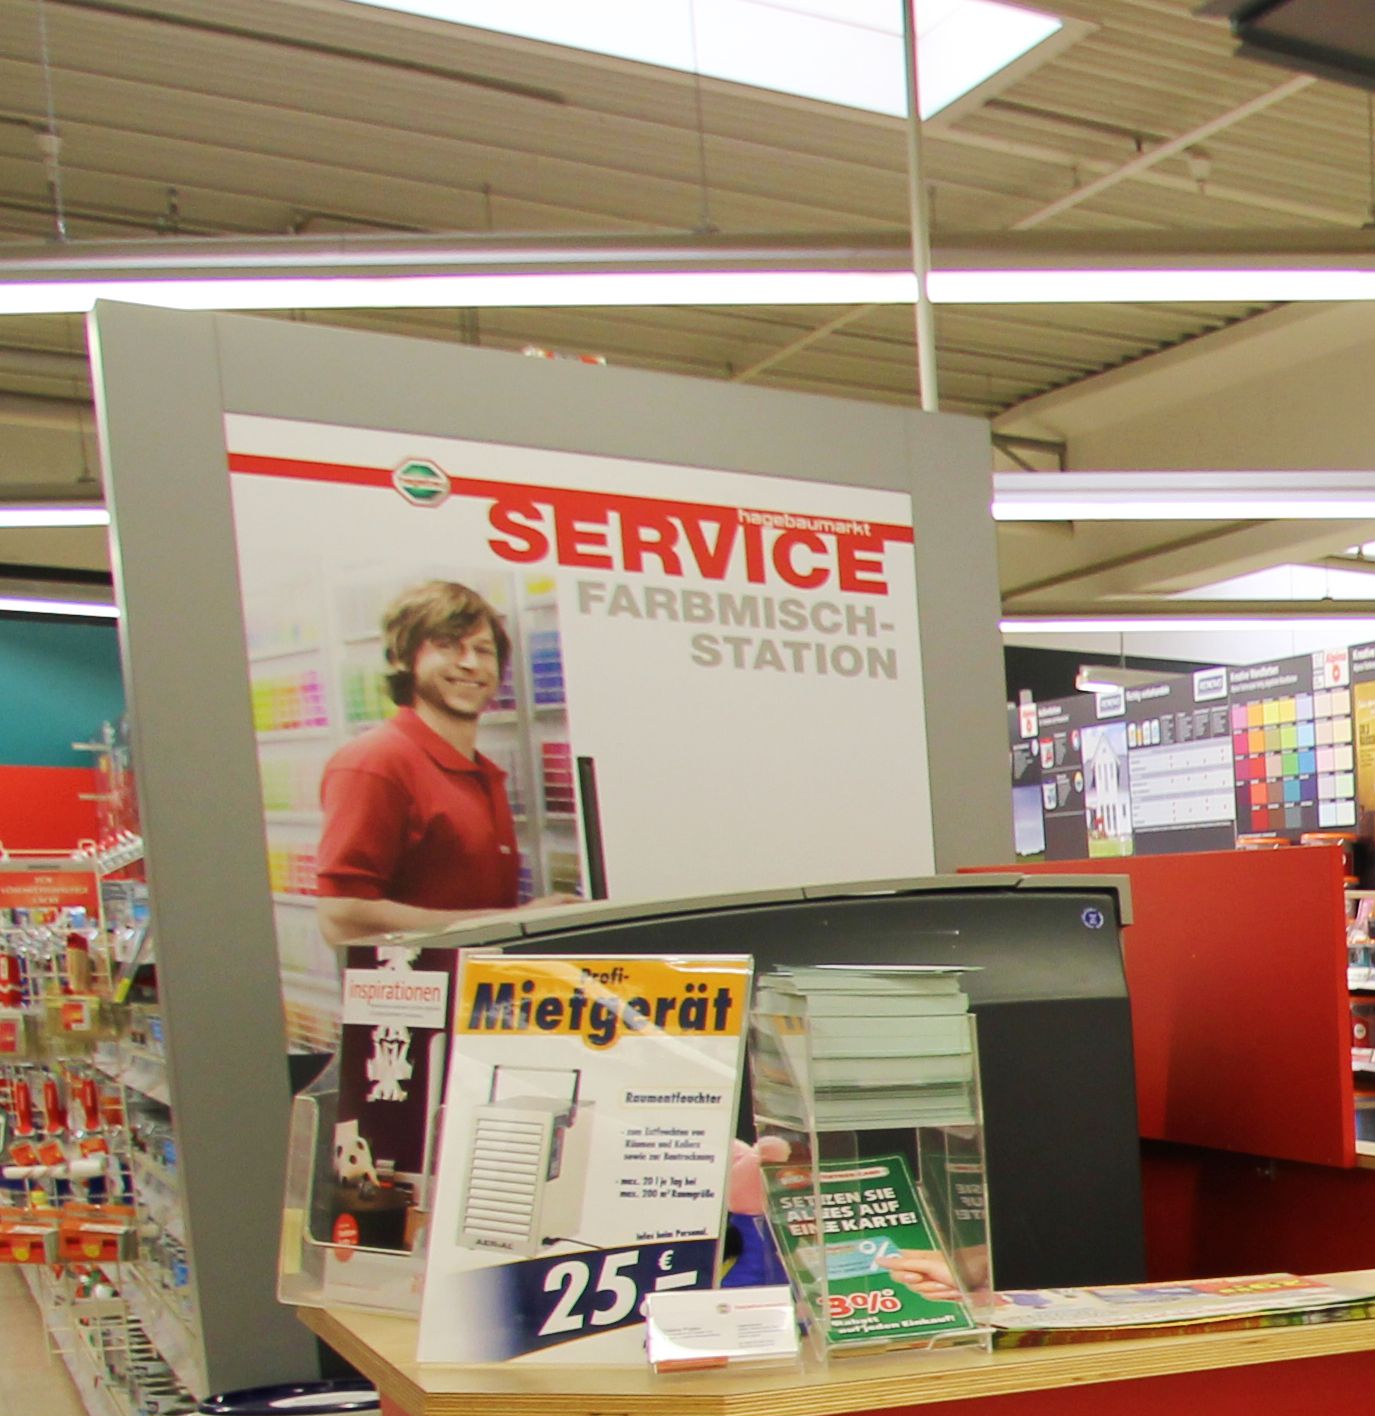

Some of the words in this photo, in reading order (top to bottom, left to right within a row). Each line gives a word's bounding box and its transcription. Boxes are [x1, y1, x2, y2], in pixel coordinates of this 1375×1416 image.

[737, 508, 872, 538] hagebaumarkt
[488, 499, 890, 596] SERVICE
[576, 580, 896, 638] FARBMISCH-
[690, 634, 898, 681] STATION
[580, 966, 629, 985] Profi-
[348, 980, 442, 1004] inspirationen
[467, 981, 733, 1046] Mietgerät
[864, 1188, 896, 1201] SIE
[859, 1200, 900, 1218] AUF
[842, 1212, 918, 1232] KARTE!
[658, 1249, 675, 1271] €
